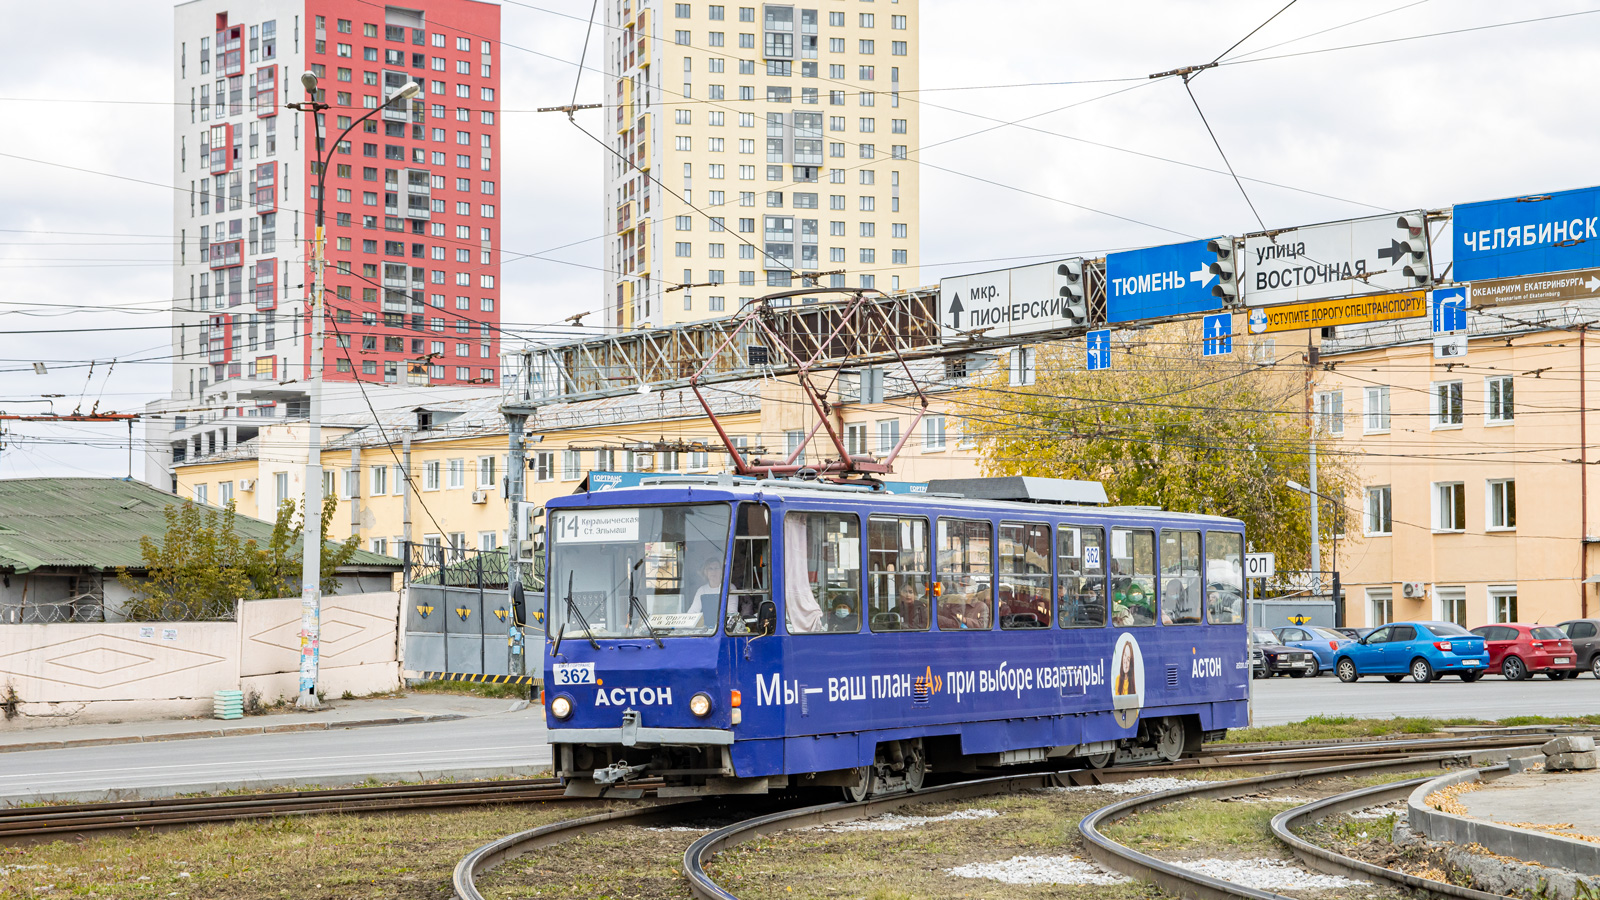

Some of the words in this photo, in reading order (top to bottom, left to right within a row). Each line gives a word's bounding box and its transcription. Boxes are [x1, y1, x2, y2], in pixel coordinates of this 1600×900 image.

[1463, 216, 1598, 251] ЧЕЛЯБИНСК
[1256, 241, 1305, 265] улица
[1112, 270, 1186, 296] ТЮМЕНЬ
[1256, 259, 1366, 290] ВОСТОЧНАЯ
[970, 285, 1000, 302] мкр.
[1472, 285, 1521, 297] ОКЕАНАРИУМ
[1524, 277, 1584, 292] ЕКАТЕРИНБУРГА
[1529, 291, 1560, 299] Ekaterinburg
[1268, 309, 1309, 326] УСТУПИТЕ
[1311, 306, 1344, 323] ДОРОГУ
[558, 515, 579, 538] 14
[581, 517, 639, 528] Керамическая
[1086, 547, 1099, 563] 362
[560, 668, 590, 684] 362
[1191, 657, 1222, 678] АСТОН
[755, 672, 799, 706] Мы
[828, 675, 866, 702] ваш
[871, 673, 911, 699] план
[946, 669, 975, 703] при
[979, 660, 1033, 699] выборе
[1036, 658, 1104, 695] квартиры!
[595, 687, 672, 706] АСТОН
